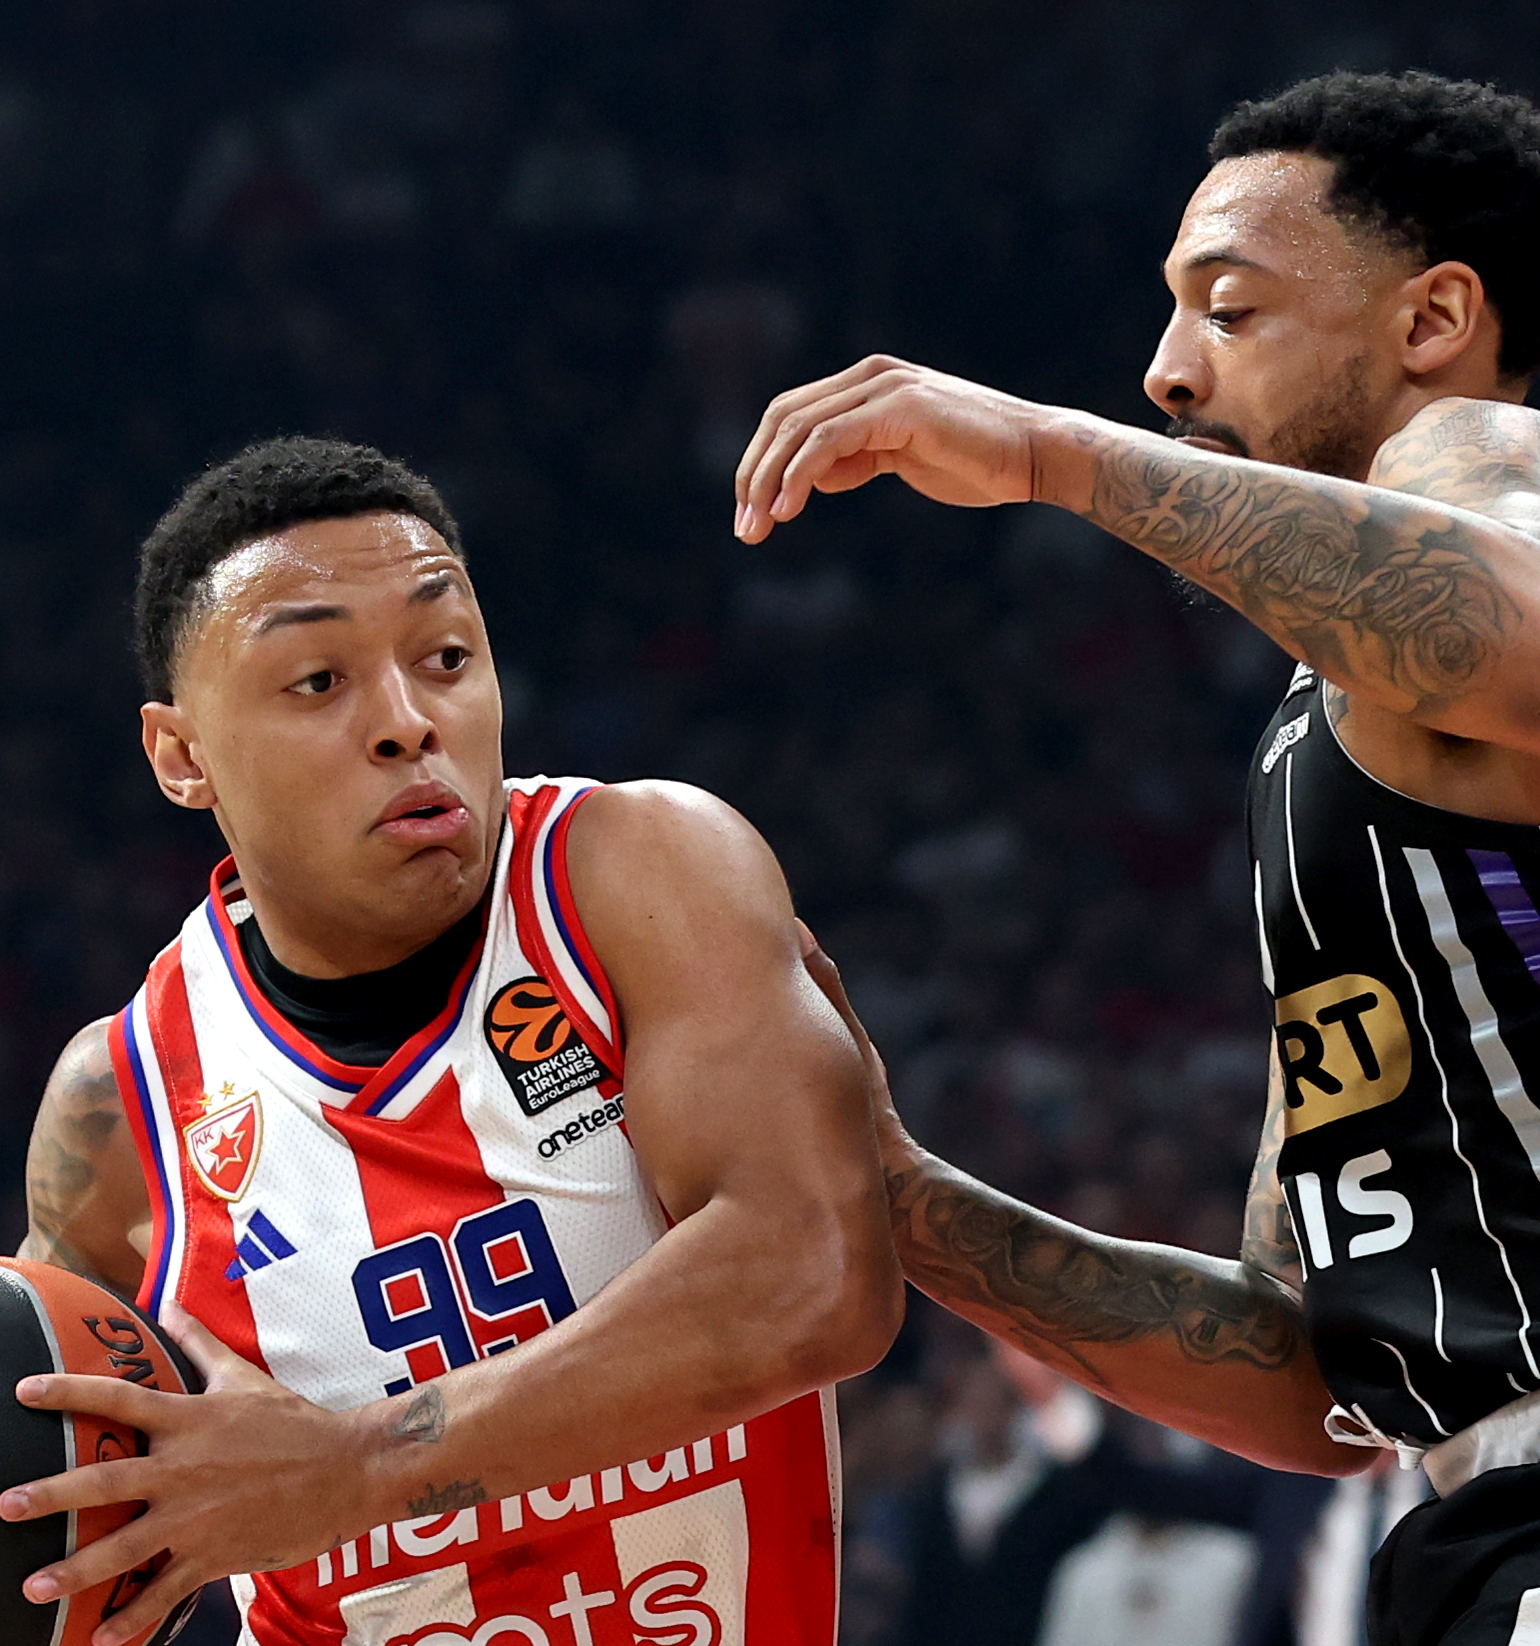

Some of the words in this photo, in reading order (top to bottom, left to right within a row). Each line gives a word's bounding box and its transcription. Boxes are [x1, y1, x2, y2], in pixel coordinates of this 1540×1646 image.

[517, 1043, 590, 1086] TURKISH
[525, 1055, 596, 1100] AIRLINES
[528, 1069, 601, 1110] EuroLeague
[537, 1096, 624, 1158] onetea
[1281, 1149, 1413, 1282] IS
[351, 1198, 580, 1397] 99
